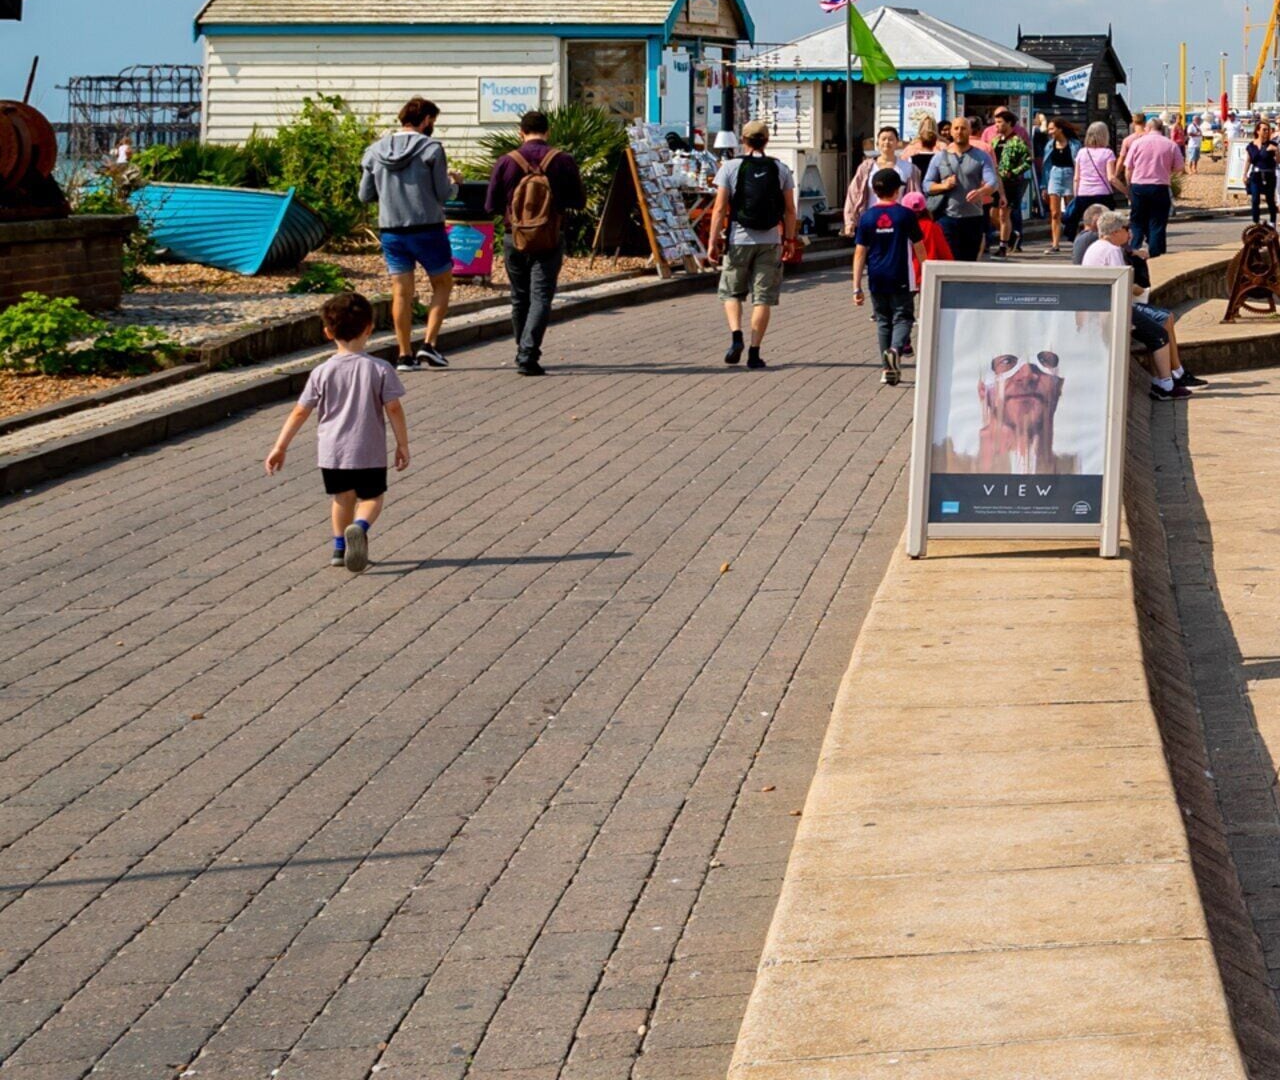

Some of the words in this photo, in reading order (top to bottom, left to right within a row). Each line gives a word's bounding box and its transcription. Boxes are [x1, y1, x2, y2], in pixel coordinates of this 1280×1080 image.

[482, 82, 537, 95] Museum
[492, 99, 527, 113] Shop
[983, 484, 1052, 497] VIEW
